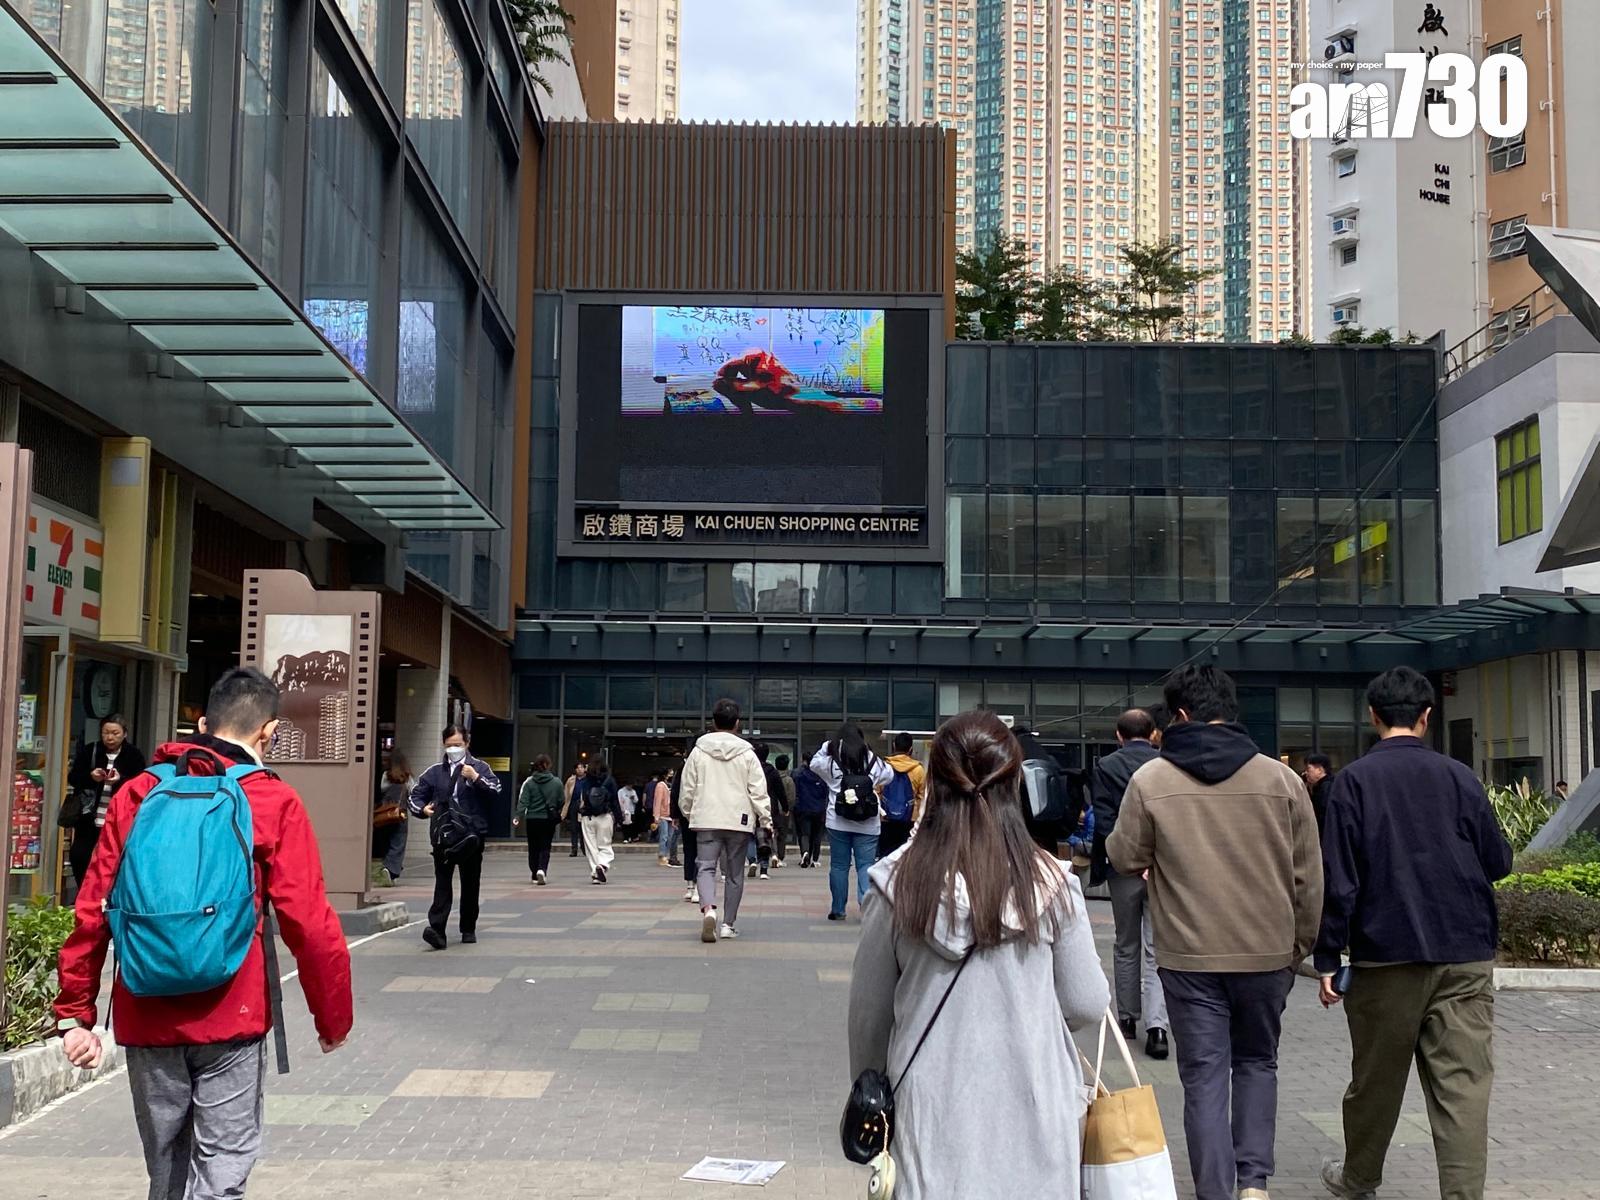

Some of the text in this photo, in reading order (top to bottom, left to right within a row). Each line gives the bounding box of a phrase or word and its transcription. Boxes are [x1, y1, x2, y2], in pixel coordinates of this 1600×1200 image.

[1434, 163, 1450, 175] KAI
[1434, 178, 1450, 190] CHI
[1419, 189, 1450, 205] HOUSE
[695, 515, 919, 532] KAI CHUEN SHOPPING CENTRE
